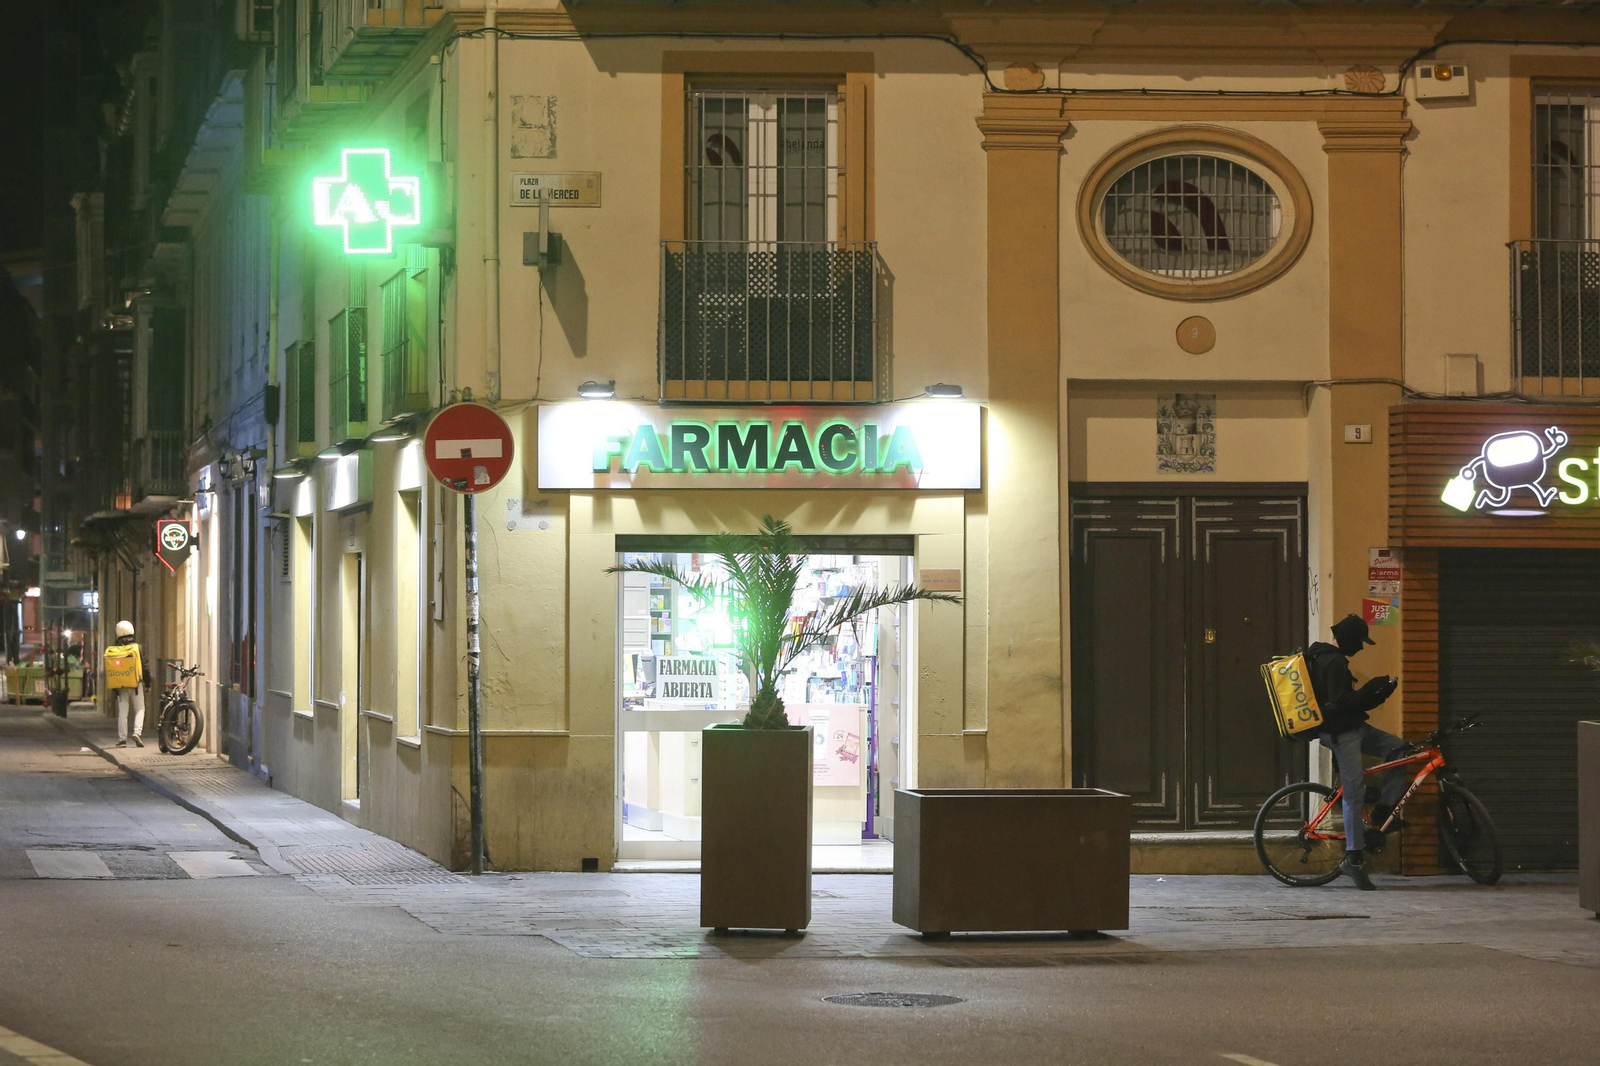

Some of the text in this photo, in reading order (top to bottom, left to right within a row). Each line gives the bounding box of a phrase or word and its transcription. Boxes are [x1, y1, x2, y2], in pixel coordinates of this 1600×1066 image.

[520, 177, 539, 186] PLAZA
[520, 188, 531, 199] DE
[548, 188, 579, 199] MERCED
[1355, 427, 1361, 439] 9
[592, 421, 925, 473] FARMACIA
[1370, 605, 1390, 613] JUST
[107, 669, 130, 677] Glovo
[659, 659, 717, 676] FARMACIA
[662, 681, 713, 698] ABIERTA
[1289, 670, 1313, 722] Glovo
